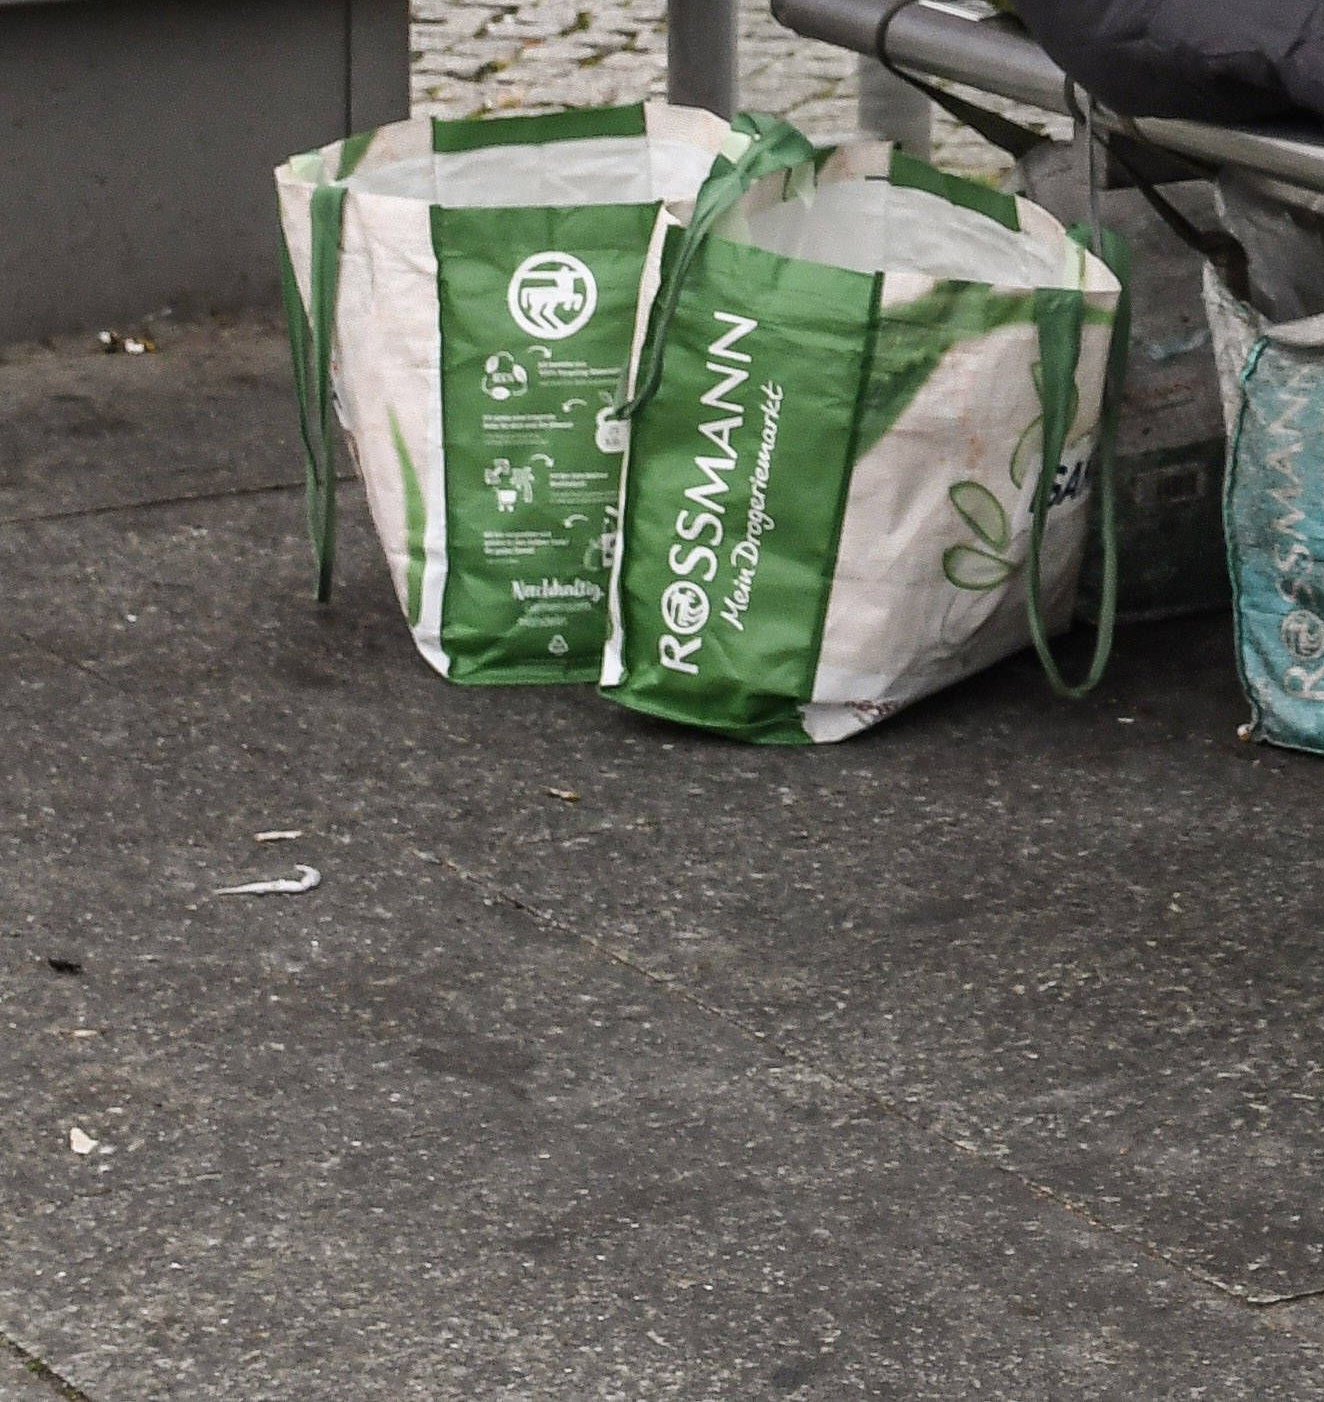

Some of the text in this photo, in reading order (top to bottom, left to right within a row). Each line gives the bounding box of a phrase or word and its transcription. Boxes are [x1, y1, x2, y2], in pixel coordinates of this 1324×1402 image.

[658, 309, 760, 676] ROSSMANN
[718, 379, 785, 632] Mein Drogeriemarkt
